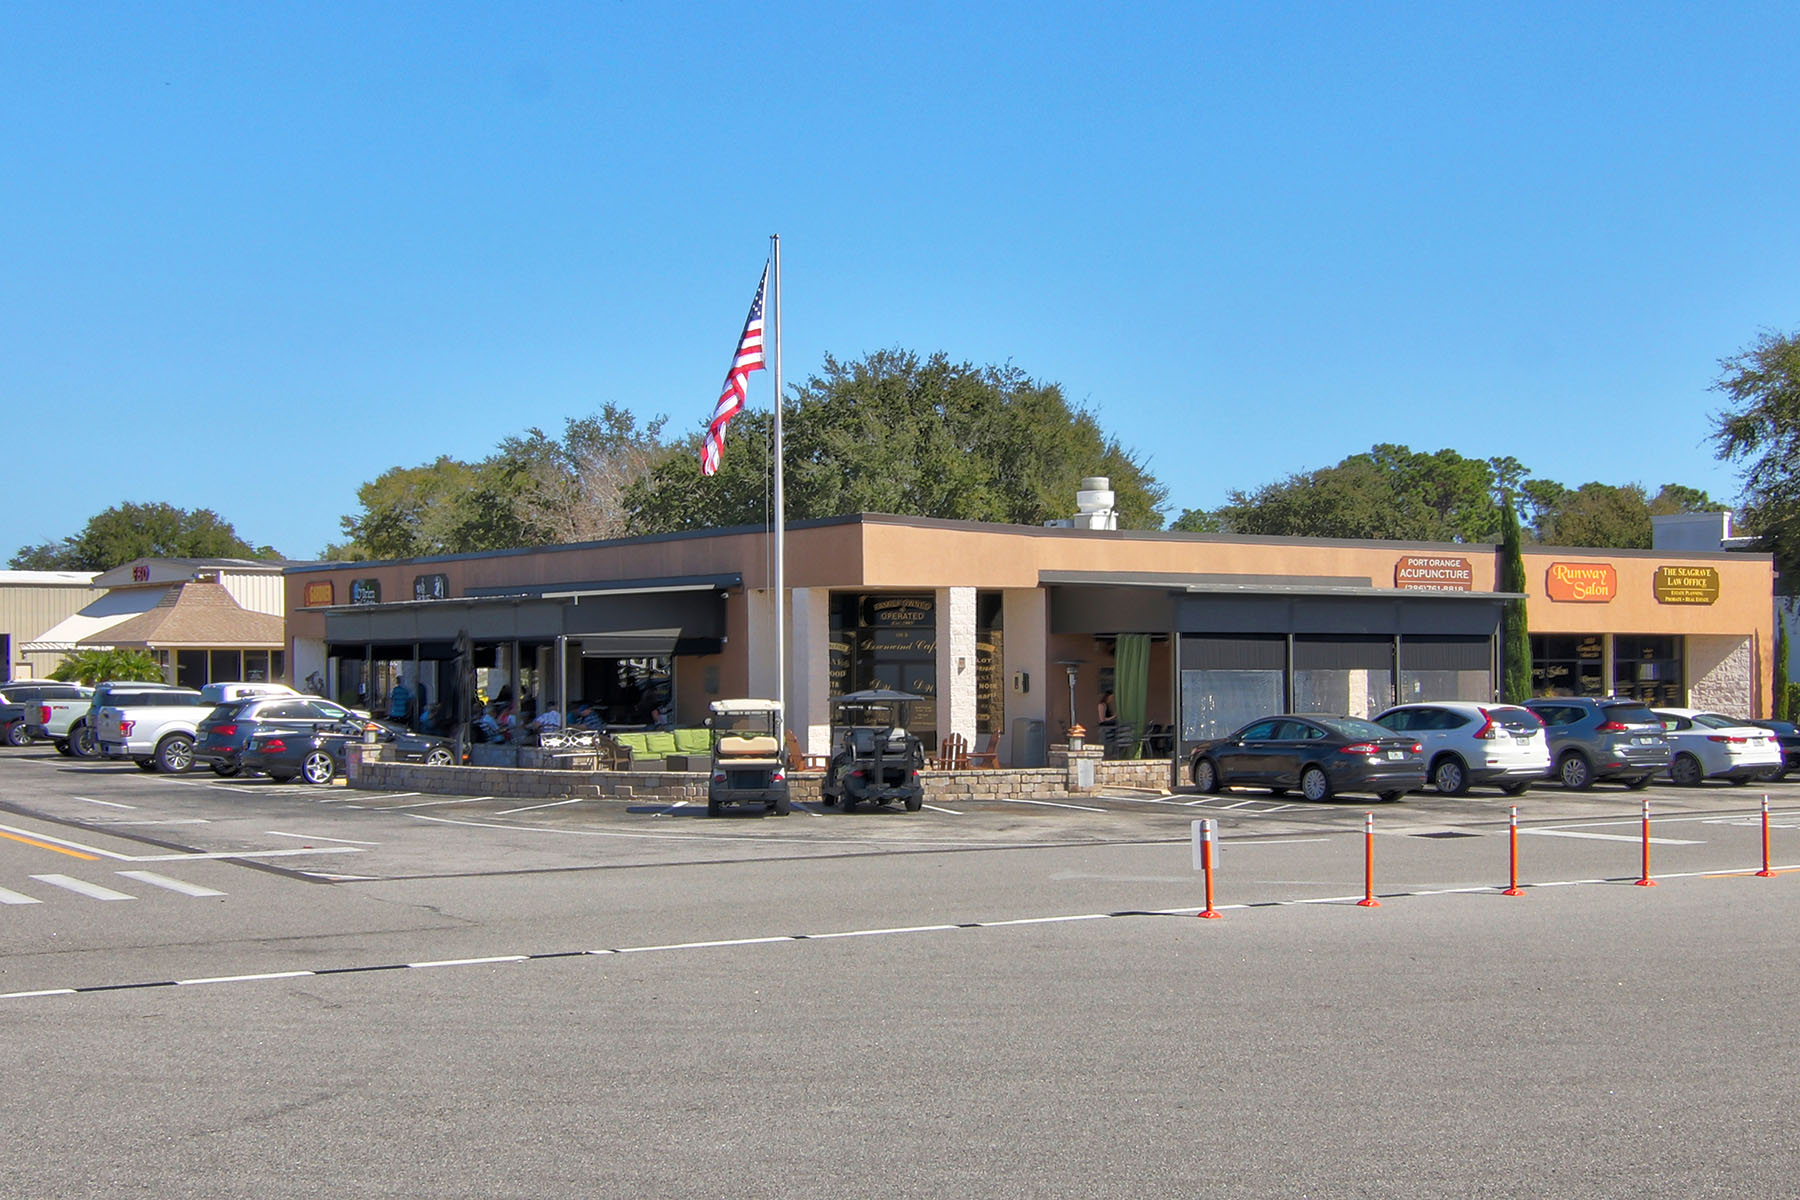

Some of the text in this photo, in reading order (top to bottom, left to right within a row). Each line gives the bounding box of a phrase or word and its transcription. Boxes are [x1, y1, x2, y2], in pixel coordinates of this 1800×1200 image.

[1408, 559, 1461, 568] PORT ORANGE
[1400, 568, 1469, 579] ACUPUNCTURE
[1553, 565, 1607, 585] Runway
[1663, 568, 1711, 577] THE SEAGRAVE
[1667, 577, 1707, 587] LAW OFFICE
[1573, 582, 1608, 599] Salon
[880, 612, 925, 620] OPERATED
[915, 640, 936, 654] Caf
